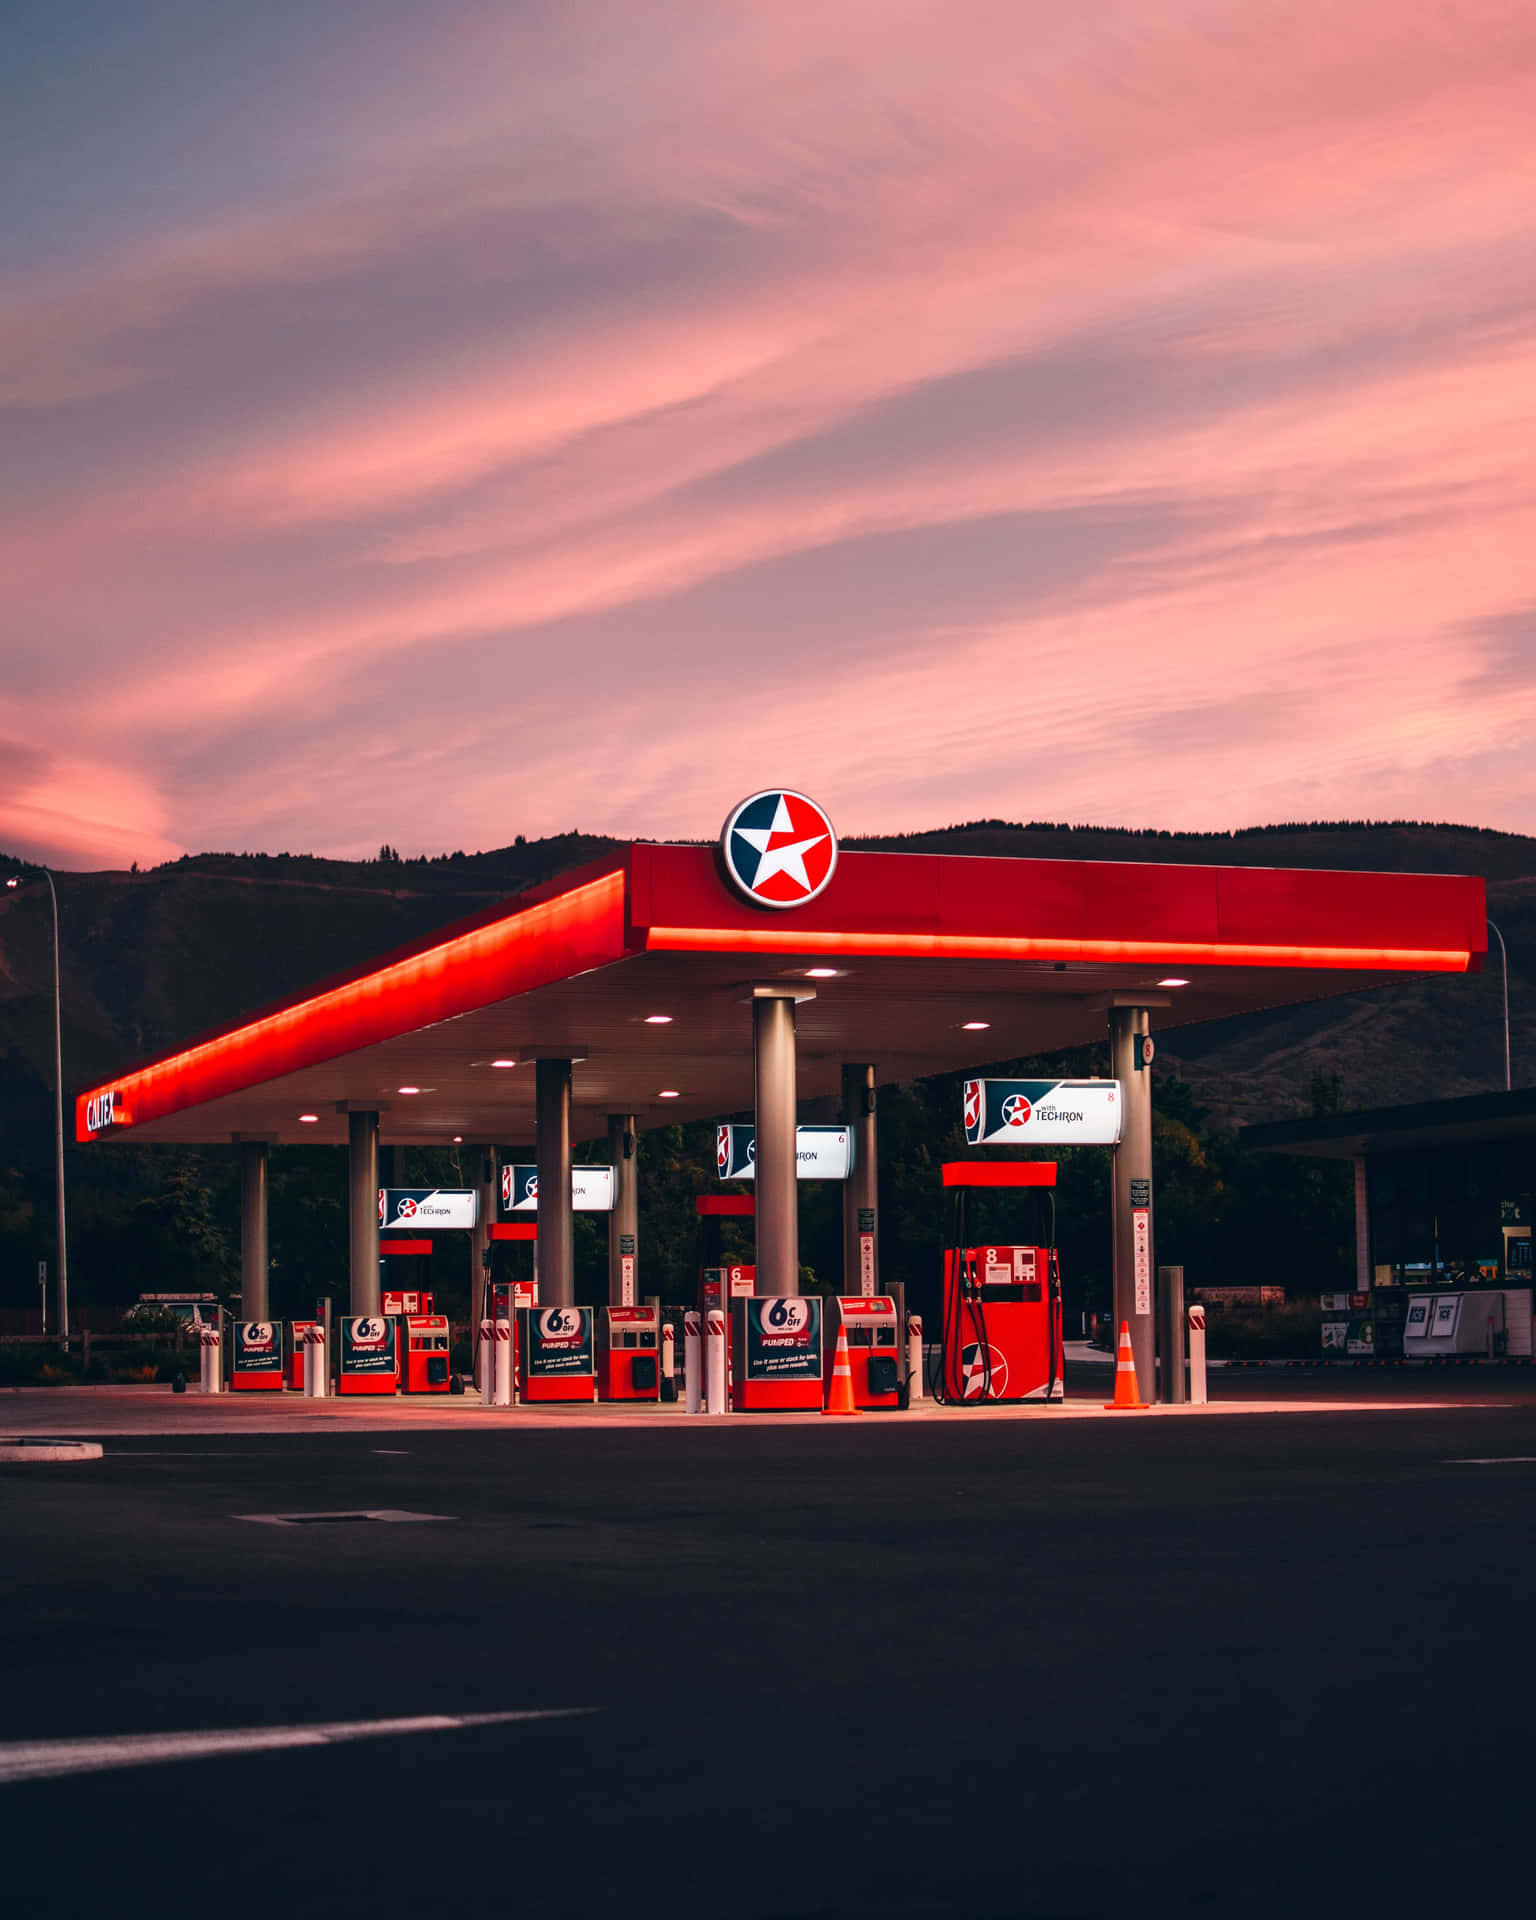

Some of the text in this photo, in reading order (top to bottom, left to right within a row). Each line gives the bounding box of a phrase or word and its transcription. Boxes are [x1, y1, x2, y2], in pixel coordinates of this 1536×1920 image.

[1107, 1092, 1115, 1103] 8
[87, 1091, 114, 1131] CALTEX
[1035, 1109, 1084, 1124] TECHRON
[838, 1134, 845, 1144] 6
[985, 1248, 998, 1264] 8
[731, 1267, 742, 1281] 6
[514, 1283, 522, 1295] 4
[384, 1292, 393, 1303] 2
[762, 1337, 794, 1347] PUMPED
